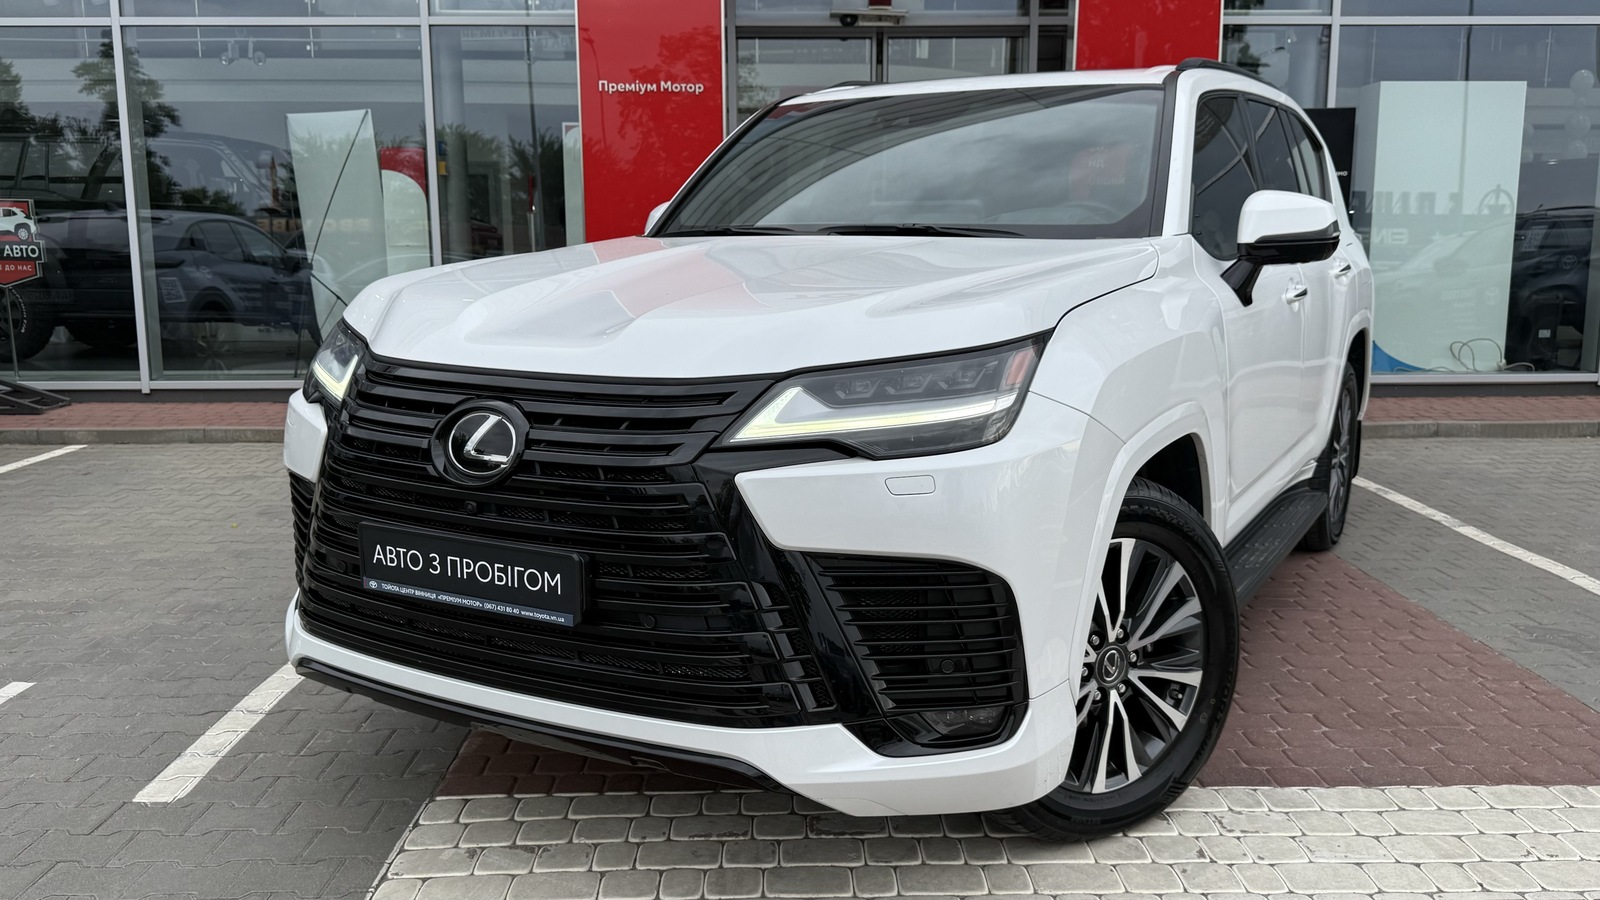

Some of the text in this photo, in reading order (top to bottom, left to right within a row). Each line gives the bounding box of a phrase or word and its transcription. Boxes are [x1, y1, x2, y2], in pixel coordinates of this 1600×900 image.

[598, 80, 704, 95] Преміум Мотор
[3, 245, 39, 258] АВТО
[5, 264, 15, 272] ДО
[17, 264, 32, 272] НАС
[373, 544, 423, 571] АВТО
[447, 555, 561, 595] ПРОБІГОМ
[381, 583, 399, 592] ТОЙОТА
[399, 587, 414, 596] ЦЕНТР
[415, 590, 436, 600] ВІННИЦЯ
[483, 602, 497, 611] (067)
[520, 610, 565, 623] www.toyota.vn.ua
